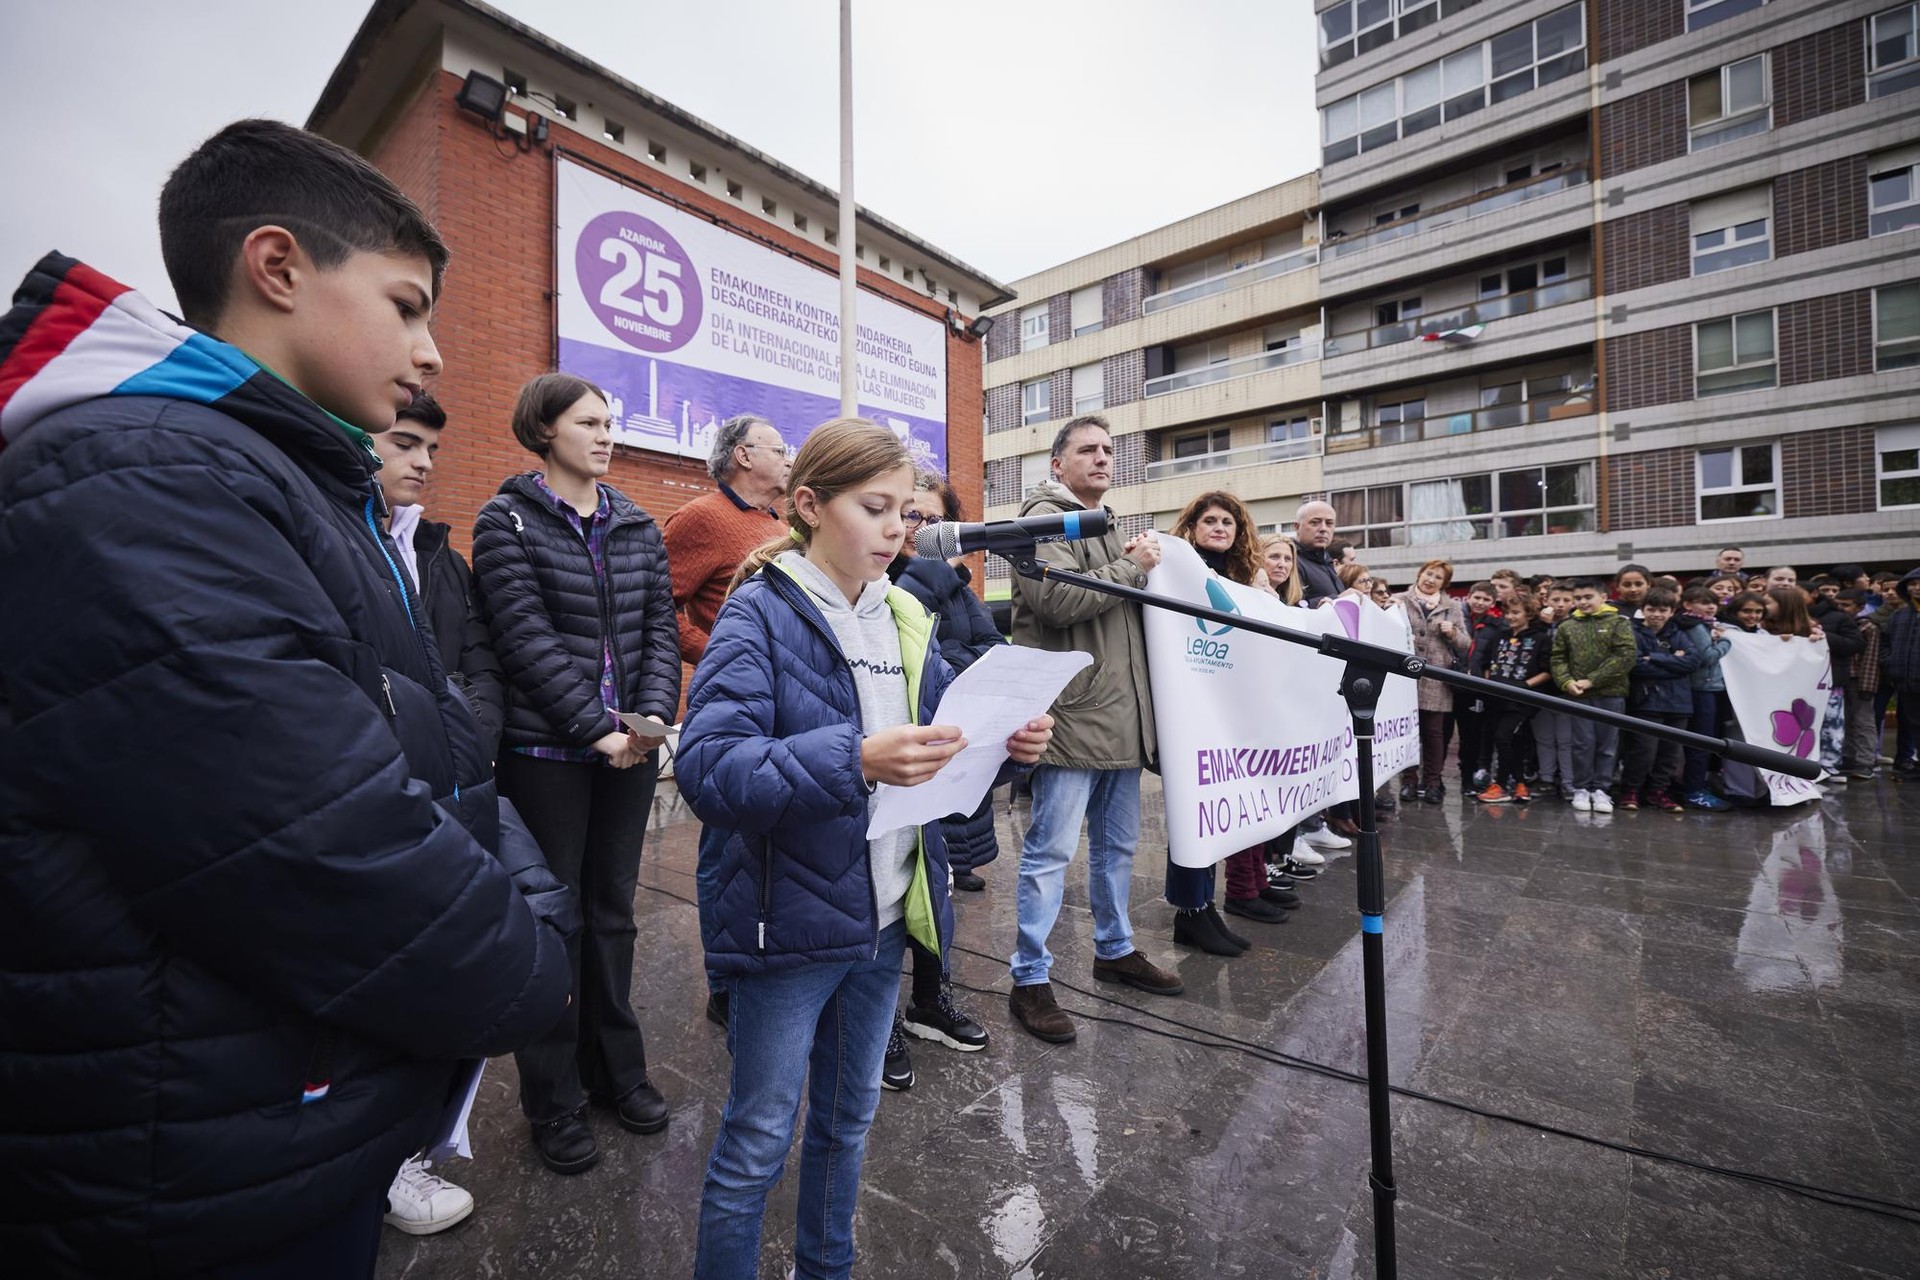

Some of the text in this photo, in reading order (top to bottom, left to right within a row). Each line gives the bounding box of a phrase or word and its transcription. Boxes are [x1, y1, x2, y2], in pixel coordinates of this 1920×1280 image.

[619, 227, 667, 254] AZAROAK
[599, 237, 684, 327] 25
[711, 267, 913, 356] EMAKUMEEN KONTRA INDARKERIA
[613, 315, 672, 343] NOVIEMBRE
[711, 285, 938, 379] DESAGERRARAZTEKO ZIOARTEKO EGUNA
[711, 313, 937, 400] DÍA INTERNACIONAL PA LA ELIMINACIÓN
[711, 331, 926, 411] DE LA VIOLENCIA CON LAS MUJERES
[1197, 742, 1320, 786] EMAKUMEEN
[1198, 797, 1231, 838] NO
[1238, 793, 1250, 829] A
[1250, 788, 1273, 823] LA
[1278, 770, 1338, 816] VIOLENC
